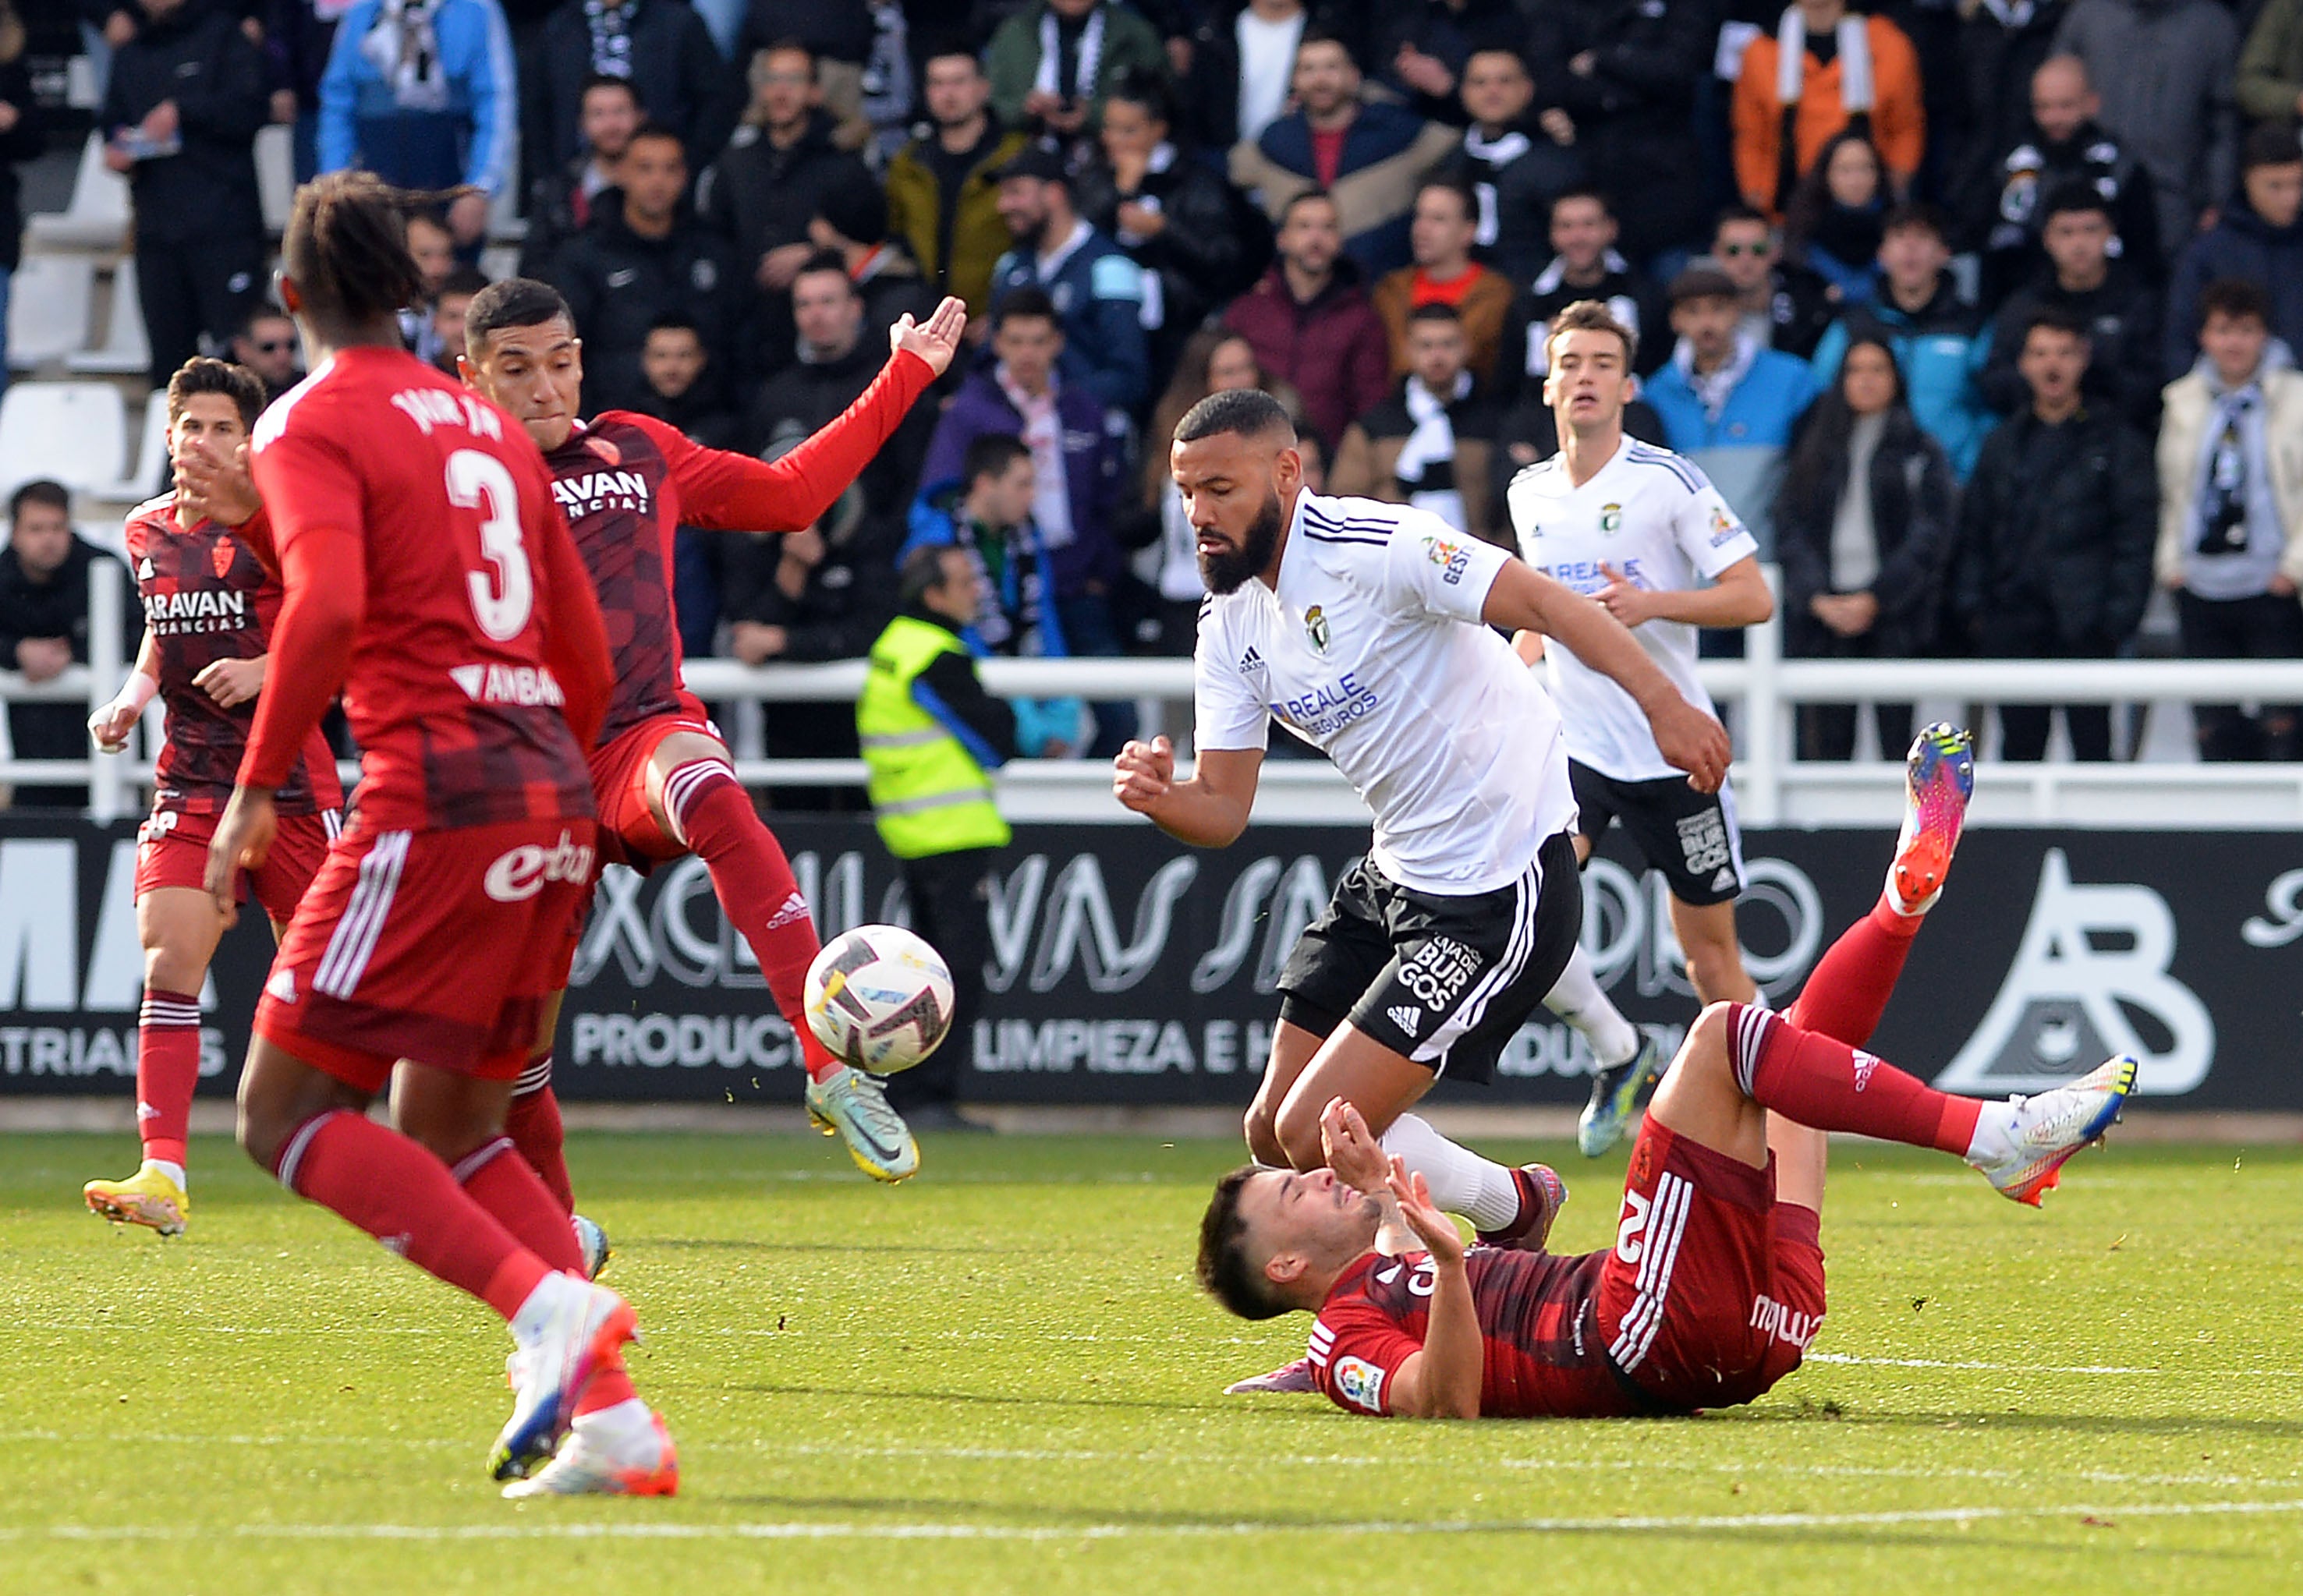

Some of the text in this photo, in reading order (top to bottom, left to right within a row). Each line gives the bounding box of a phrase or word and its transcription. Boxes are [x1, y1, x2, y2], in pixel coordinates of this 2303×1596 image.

[445, 448, 533, 642] 3
[1288, 672, 1366, 721] REALE
[1398, 962, 1451, 1012] GOS
[1413, 941, 1468, 996] BUR
[572, 1014, 805, 1068] PRODUC
[972, 1018, 1196, 1074] LIMPIEZA
[1203, 1018, 1238, 1074] E
